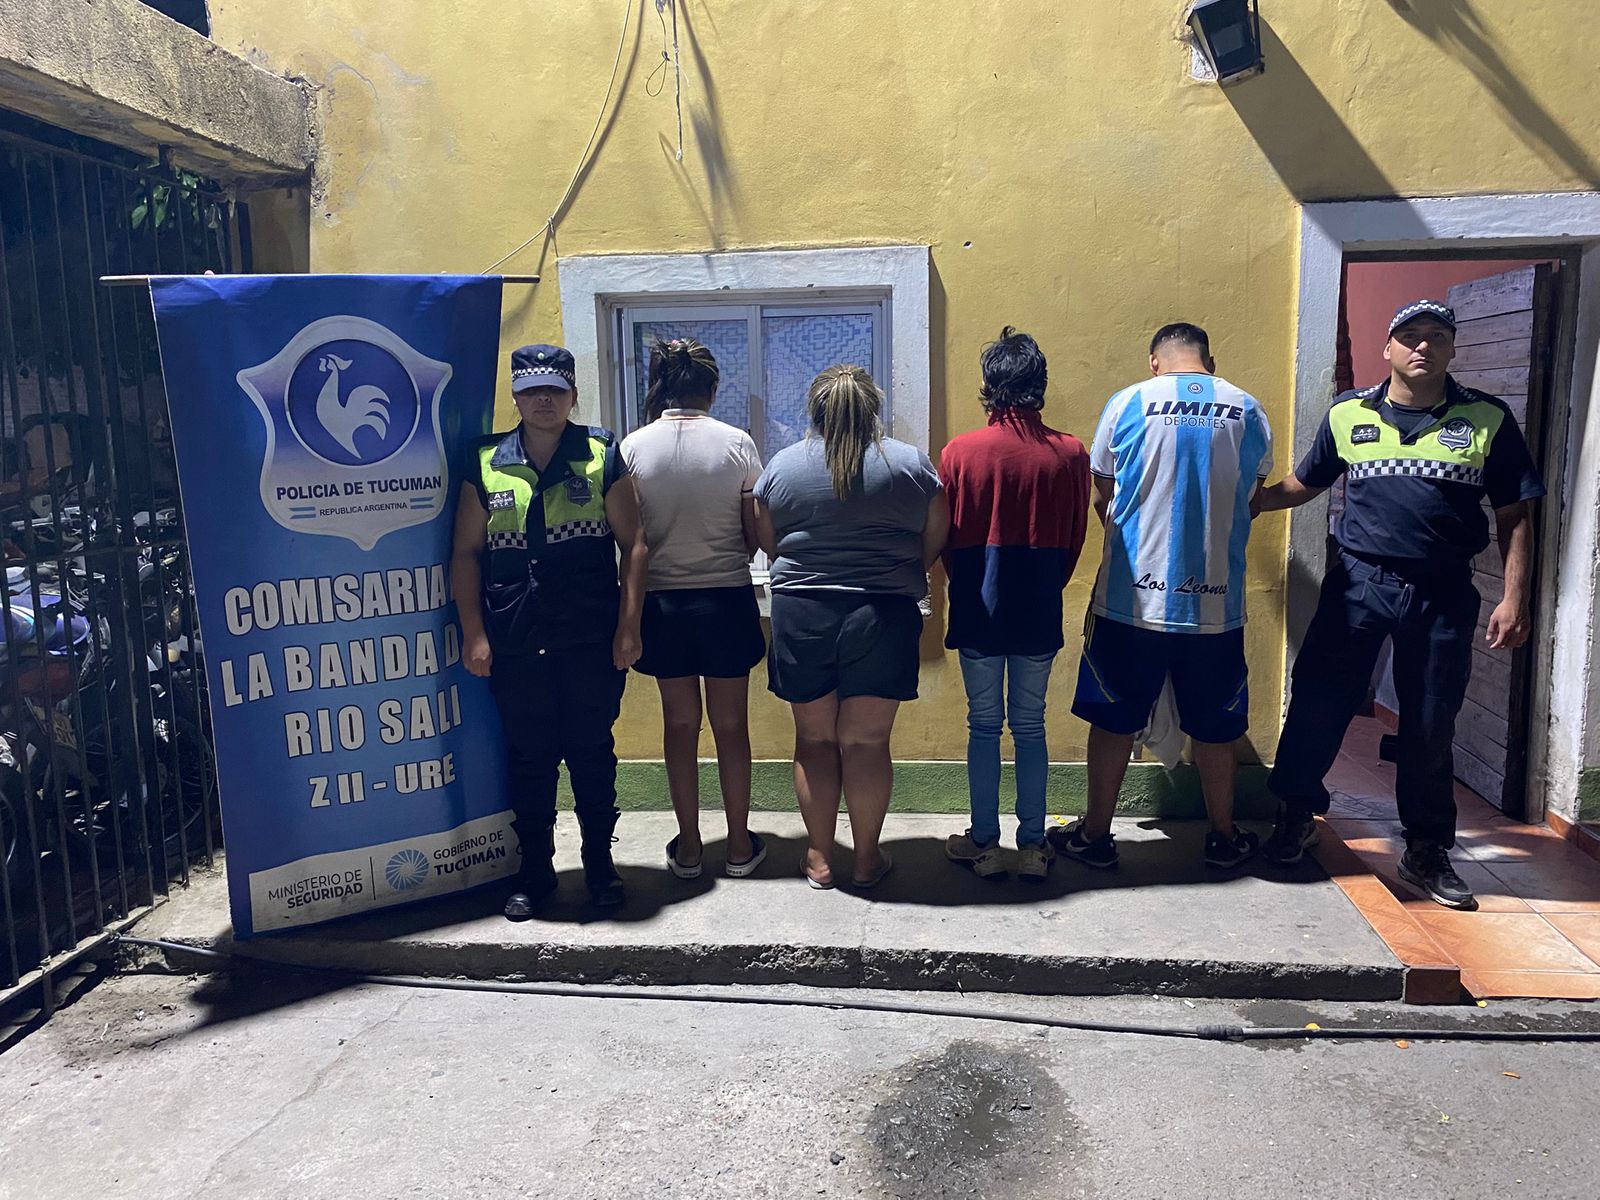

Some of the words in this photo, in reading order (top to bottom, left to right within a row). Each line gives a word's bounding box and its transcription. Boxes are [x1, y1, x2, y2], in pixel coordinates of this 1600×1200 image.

[1145, 401, 1244, 421] LIMITE
[1164, 416, 1226, 429] DEPORTES
[276, 483, 341, 501] POLICIA
[343, 481, 364, 496] DE
[367, 475, 442, 494] TUCUMAN
[319, 505, 363, 516] REPUBLICA
[363, 502, 408, 513] ARGENTINA
[1132, 573, 1167, 591] Los
[223, 563, 448, 636] COMISARIA
[220, 652, 274, 707] LA
[283, 631, 440, 692] BANDA
[284, 705, 366, 758] RIO
[378, 683, 462, 745] SALI
[309, 776, 332, 809] Z
[337, 771, 365, 805] II
[394, 753, 456, 794] URE
[433, 835, 487, 860] GOBIERNO
[489, 830, 504, 843] DE
[433, 846, 506, 876] TUCUMÁN
[268, 873, 341, 900] MINISTERIO
[344, 869, 363, 883] DE
[287, 882, 363, 909] SEGURIDAD
